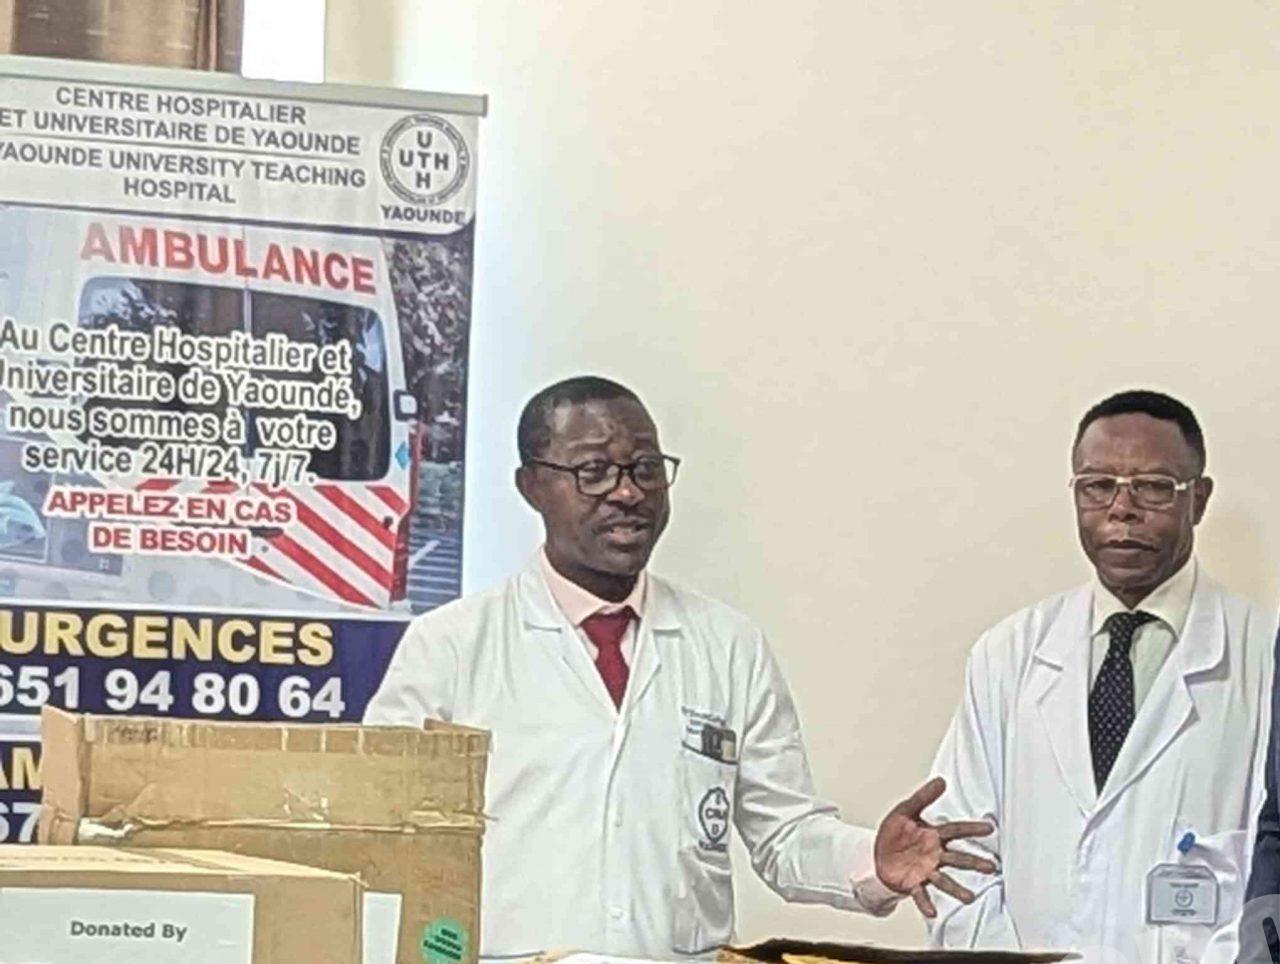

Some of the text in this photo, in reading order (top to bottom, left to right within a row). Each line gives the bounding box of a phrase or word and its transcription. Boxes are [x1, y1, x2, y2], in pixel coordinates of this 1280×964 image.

[56, 86, 307, 125] CENTRE HOSPITALIER
[34, 111, 208, 143] UNIVERSITAIRE
[214, 125, 246, 146] DE
[251, 128, 361, 156] YAOUNDE
[0, 141, 366, 188] AOUNDE UNIVERSITY TEACHING
[123, 177, 237, 204] HOSPITAL
[381, 203, 465, 224] YAOUNDE
[80, 222, 377, 295] AMBULANCE
[1, 319, 349, 373] Au Centre Hospitalier et
[182, 371, 217, 400] de
[226, 373, 359, 417] Yaoundé,
[9, 405, 334, 446] nous sommes à votre
[25, 443, 132, 473] service
[142, 446, 249, 483] 24H/24,
[49, 491, 292, 524] APPELEZ EN CAS
[92, 526, 249, 554] DE BESOIN
[0, 610, 334, 666] URGENCES
[103, 668, 174, 711] 94
[191, 672, 261, 716] 80
[277, 675, 346, 718] 64
[70, 920, 188, 943] Donated By
